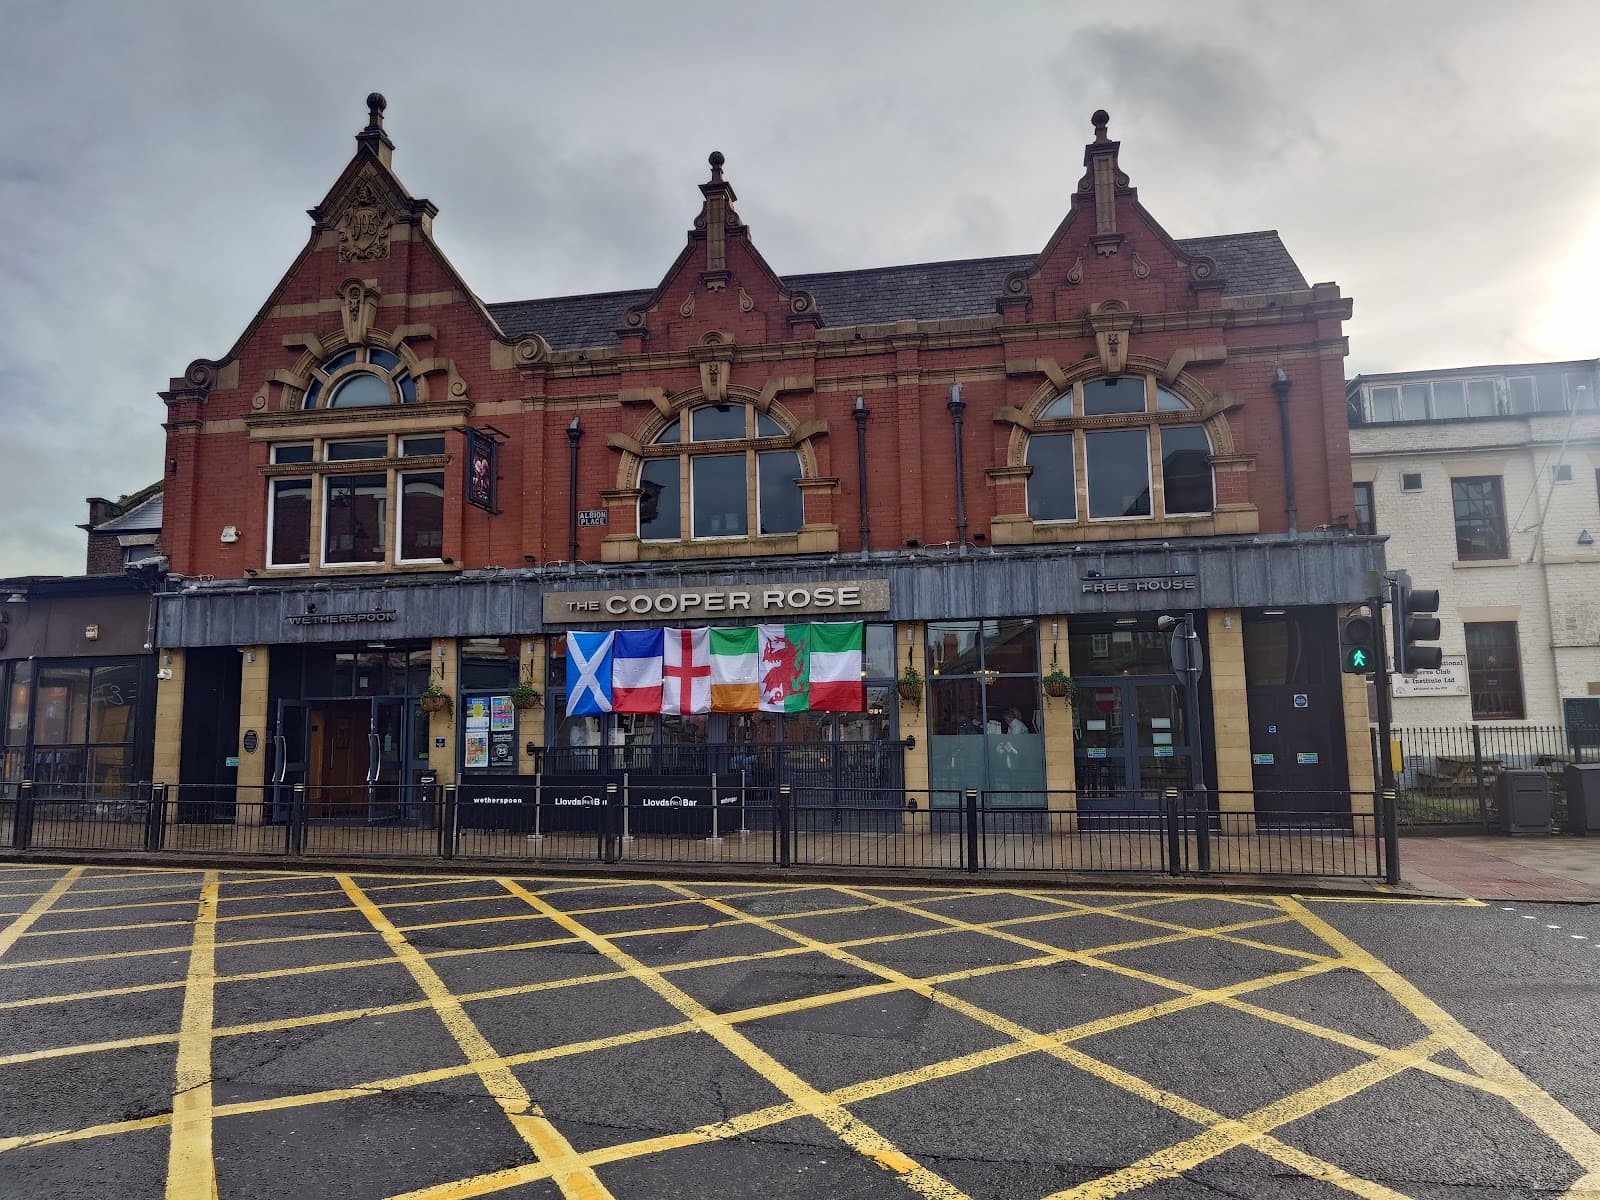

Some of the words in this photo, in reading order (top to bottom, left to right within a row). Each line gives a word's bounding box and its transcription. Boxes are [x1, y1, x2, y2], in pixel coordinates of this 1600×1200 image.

[580, 511, 606, 519] ALBION
[1082, 583, 1129, 593] FREE
[1136, 580, 1196, 591] HOUSE
[567, 600, 600, 611] THE
[605, 591, 752, 615] COOPER
[763, 586, 862, 609] ROSE
[287, 613, 396, 625] WETHERSPOON
[682, 798, 698, 807] Bar
